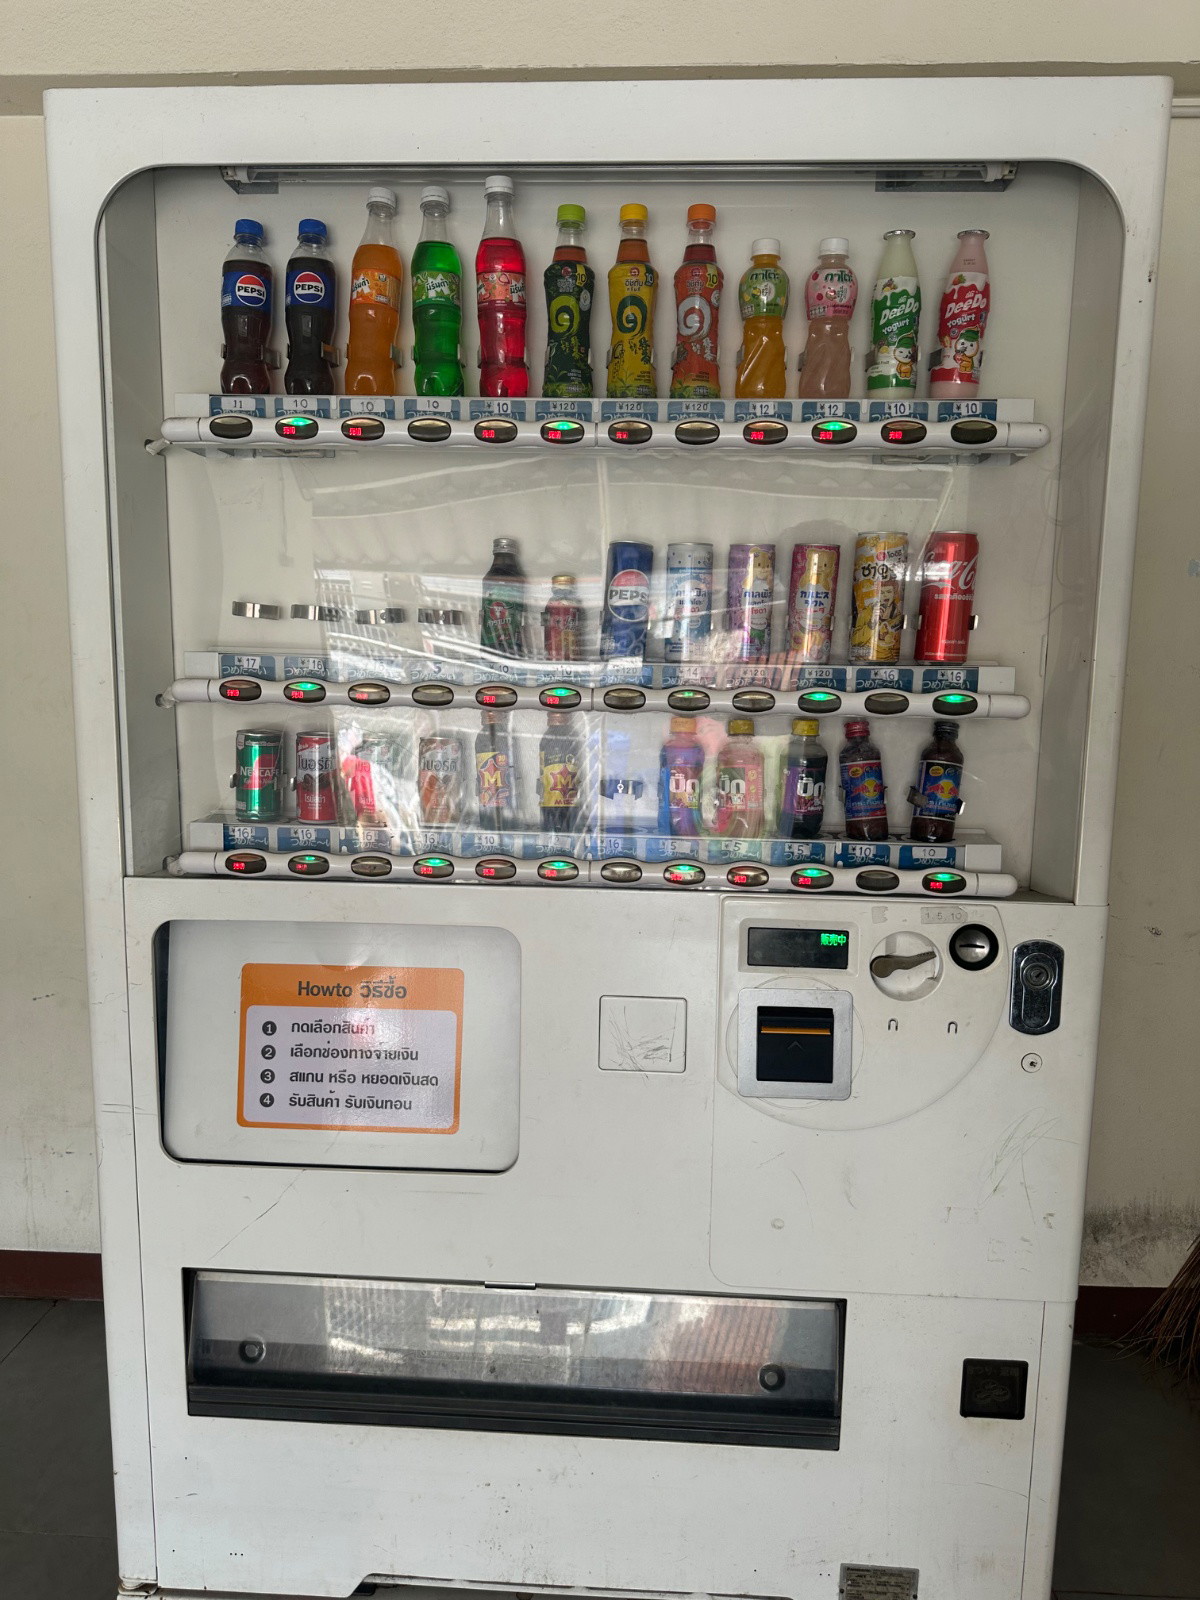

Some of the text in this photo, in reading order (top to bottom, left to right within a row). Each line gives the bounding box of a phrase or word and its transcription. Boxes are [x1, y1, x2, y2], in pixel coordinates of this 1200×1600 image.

[577, 273, 586, 283] 10
[646, 273, 654, 283] 10
[708, 273, 718, 284] 10
[237, 285, 265, 298] PEPSI
[295, 283, 323, 293] PEPSI
[293, 399, 308, 409] 10
[360, 401, 374, 412] 10
[427, 400, 440, 409] 10
[552, 402, 576, 411] ¥120
[619, 403, 642, 411] ¥120
[685, 403, 709, 411] ¥120
[609, 589, 649, 603] PEPS
[800, 590, 830, 599] カルピス
[483, 771, 502, 788] M
[557, 774, 573, 789] M
[923, 849, 936, 857] 10
[298, 981, 353, 998] Howto
[291, 1017, 376, 1034] กดเลือกสินค้า
[290, 1041, 419, 1061] เลือกช่องทางจ่ายเงิน
[289, 1071, 324, 1083] สแกน
[329, 1069, 356, 1084] หรือ
[361, 1072, 439, 1087] หยอดเงินสด
[289, 1090, 340, 1108] รับสินค้า
[345, 1095, 412, 1110] รับเงินทอน
